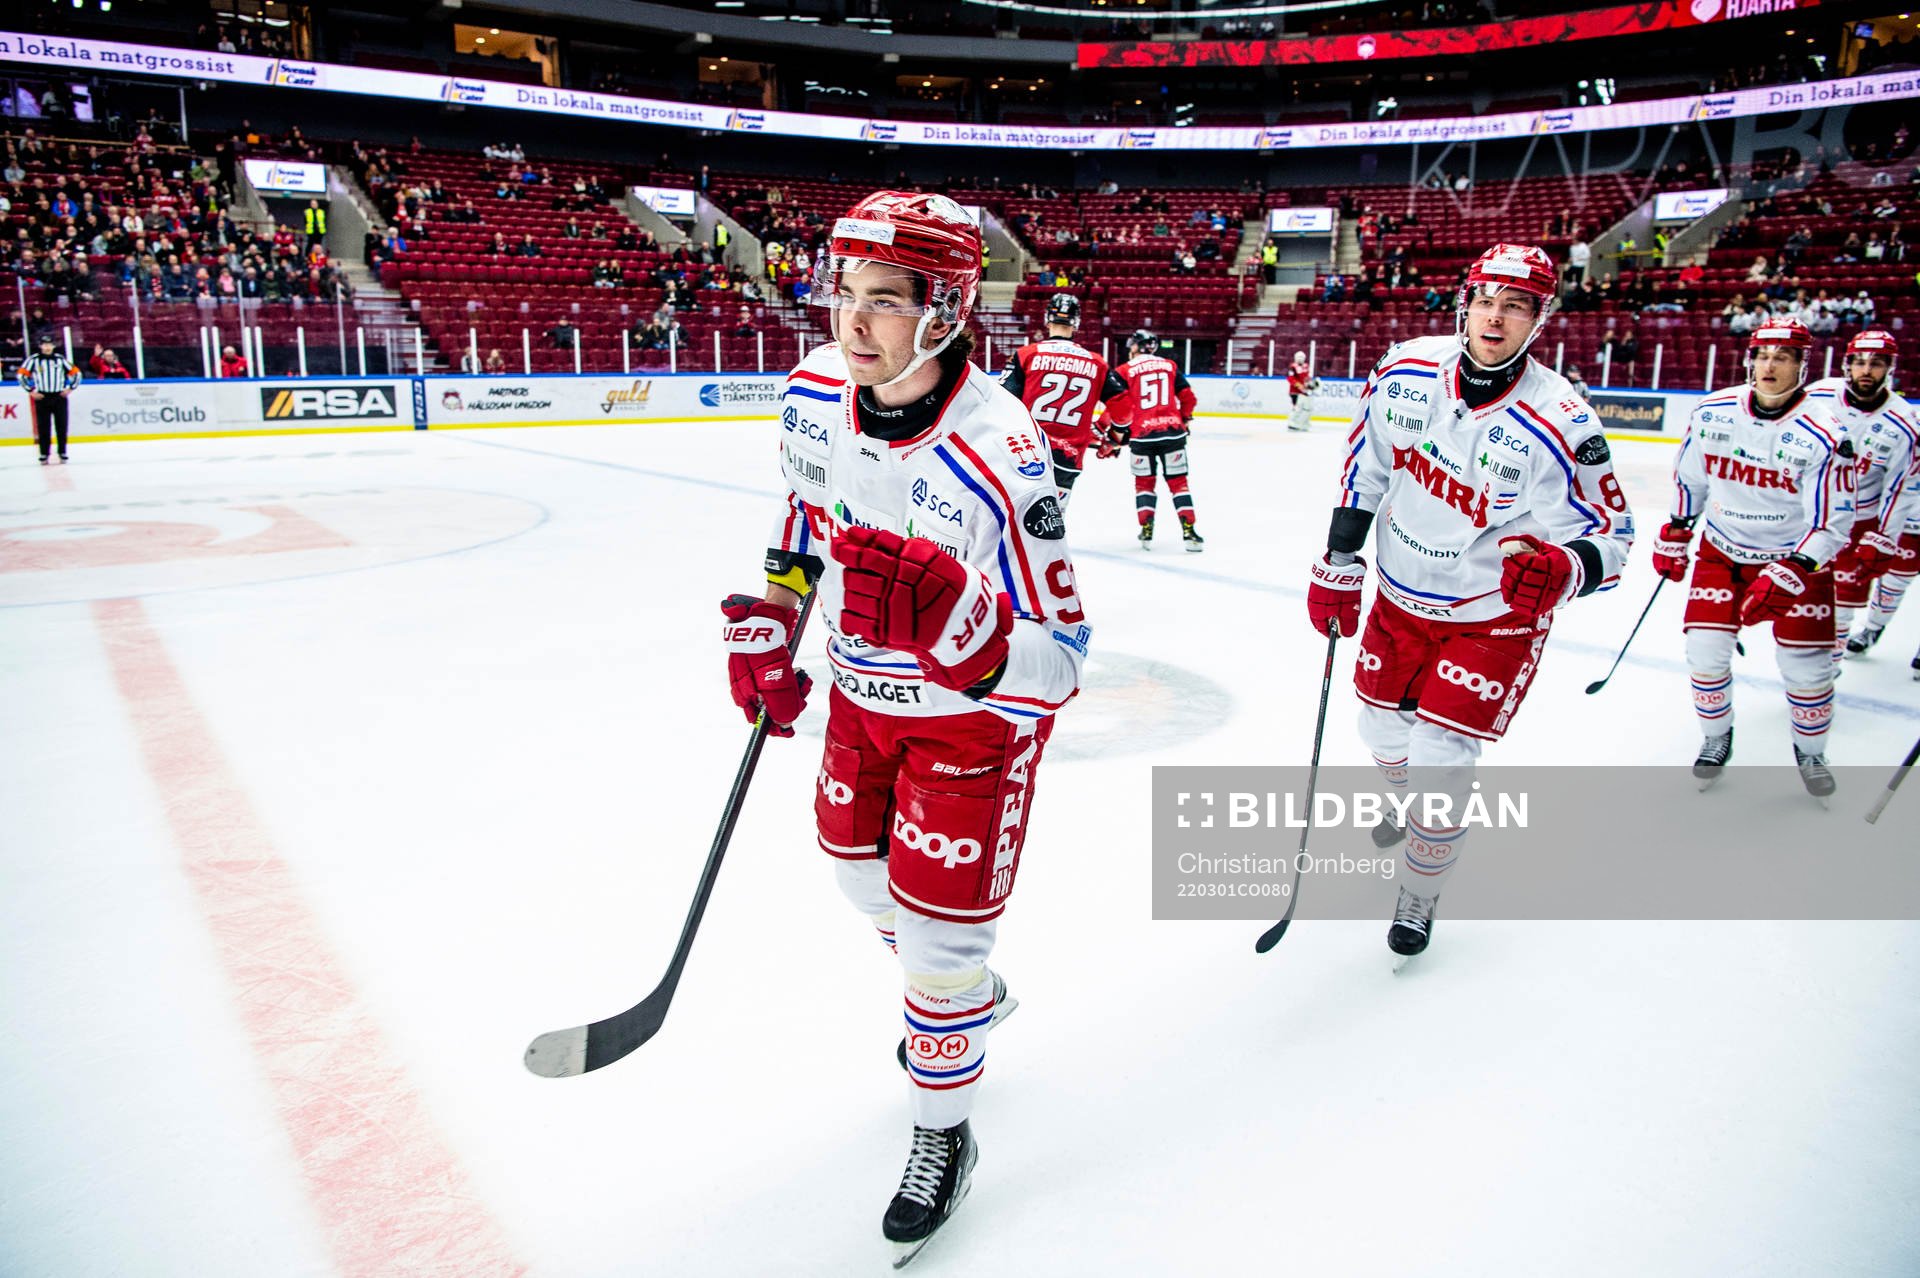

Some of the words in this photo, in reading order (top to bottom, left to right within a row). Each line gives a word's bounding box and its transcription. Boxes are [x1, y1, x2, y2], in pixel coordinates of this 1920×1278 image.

[17, 37, 92, 61] lokala
[100, 51, 235, 74] matgrossist
[517, 89, 548, 106] Din
[553, 93, 604, 112] lokala
[610, 104, 704, 122] matgrossist
[1769, 89, 1803, 106] Din
[1811, 81, 1874, 101] lokala
[924, 127, 950, 140] Din
[955, 127, 1001, 142] lokala
[1006, 133, 1095, 146] matgrossist
[1319, 129, 1348, 142] Din
[1353, 125, 1402, 140] lokala
[1408, 121, 1506, 138] matgrossist
[1030, 355, 1098, 379] BRYGGMAN
[606, 380, 652, 405] guld
[722, 381, 776, 392] HÖGTRYCKS
[758, 393, 776, 402] SYD
[1140, 372, 1169, 410] 51
[1402, 388, 1428, 405] SCA
[295, 389, 394, 417] RSA
[1030, 373, 1092, 427] 22
[1393, 414, 1423, 432] LILIUM
[1714, 414, 1734, 425] SCA
[799, 418, 829, 446] SCA
[1794, 438, 1814, 450] SCA
[860, 447, 881, 462] SHL
[1505, 435, 1530, 457] SCA
[1438, 454, 1463, 475] NHC
[1488, 458, 1521, 482] LILIUM
[1704, 453, 1798, 494] TIMRÅ
[1834, 465, 1854, 493] 10
[928, 494, 963, 528] SCA
[1045, 559, 1085, 624] 9
[723, 627, 774, 643] UER
[1437, 659, 1504, 701] coop
[893, 810, 982, 870] coop
